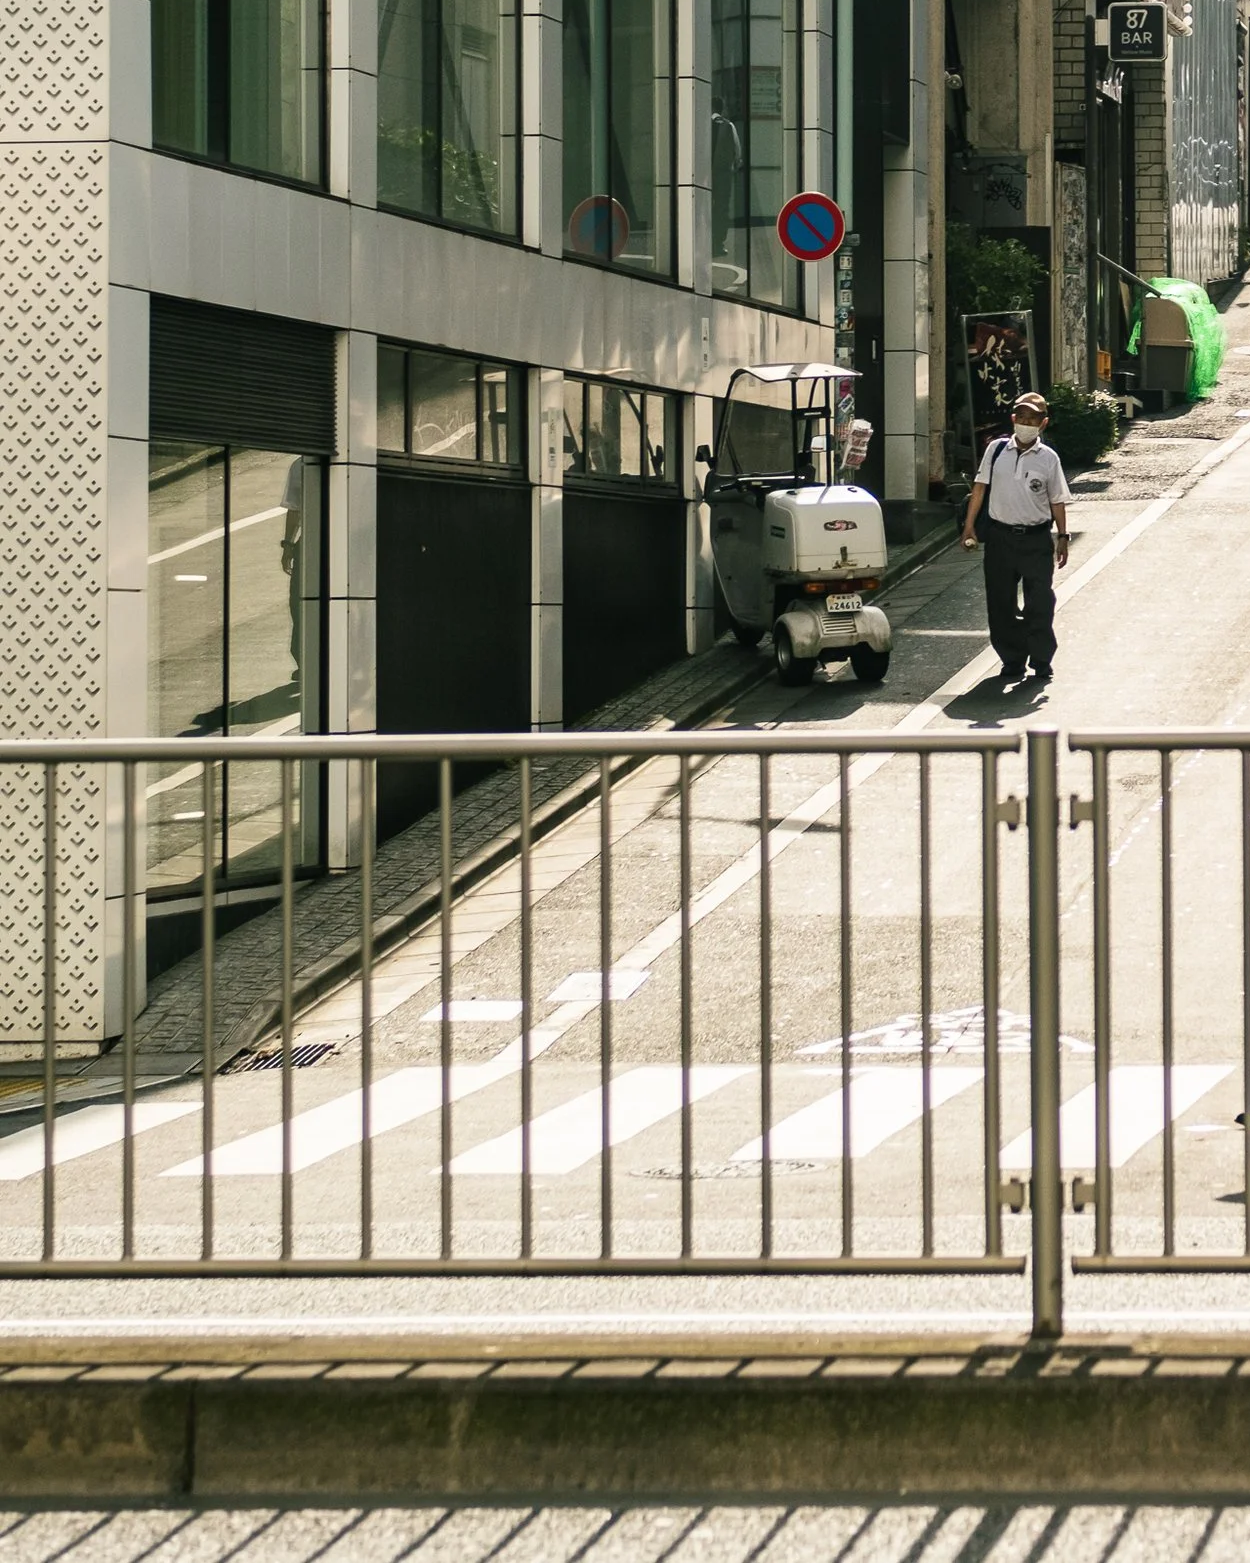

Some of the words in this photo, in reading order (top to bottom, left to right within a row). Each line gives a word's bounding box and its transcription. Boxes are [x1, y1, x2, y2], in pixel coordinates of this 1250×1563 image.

[1126, 8, 1148, 30] 87
[1121, 31, 1153, 44] BAR
[834, 601, 862, 610] 24612
